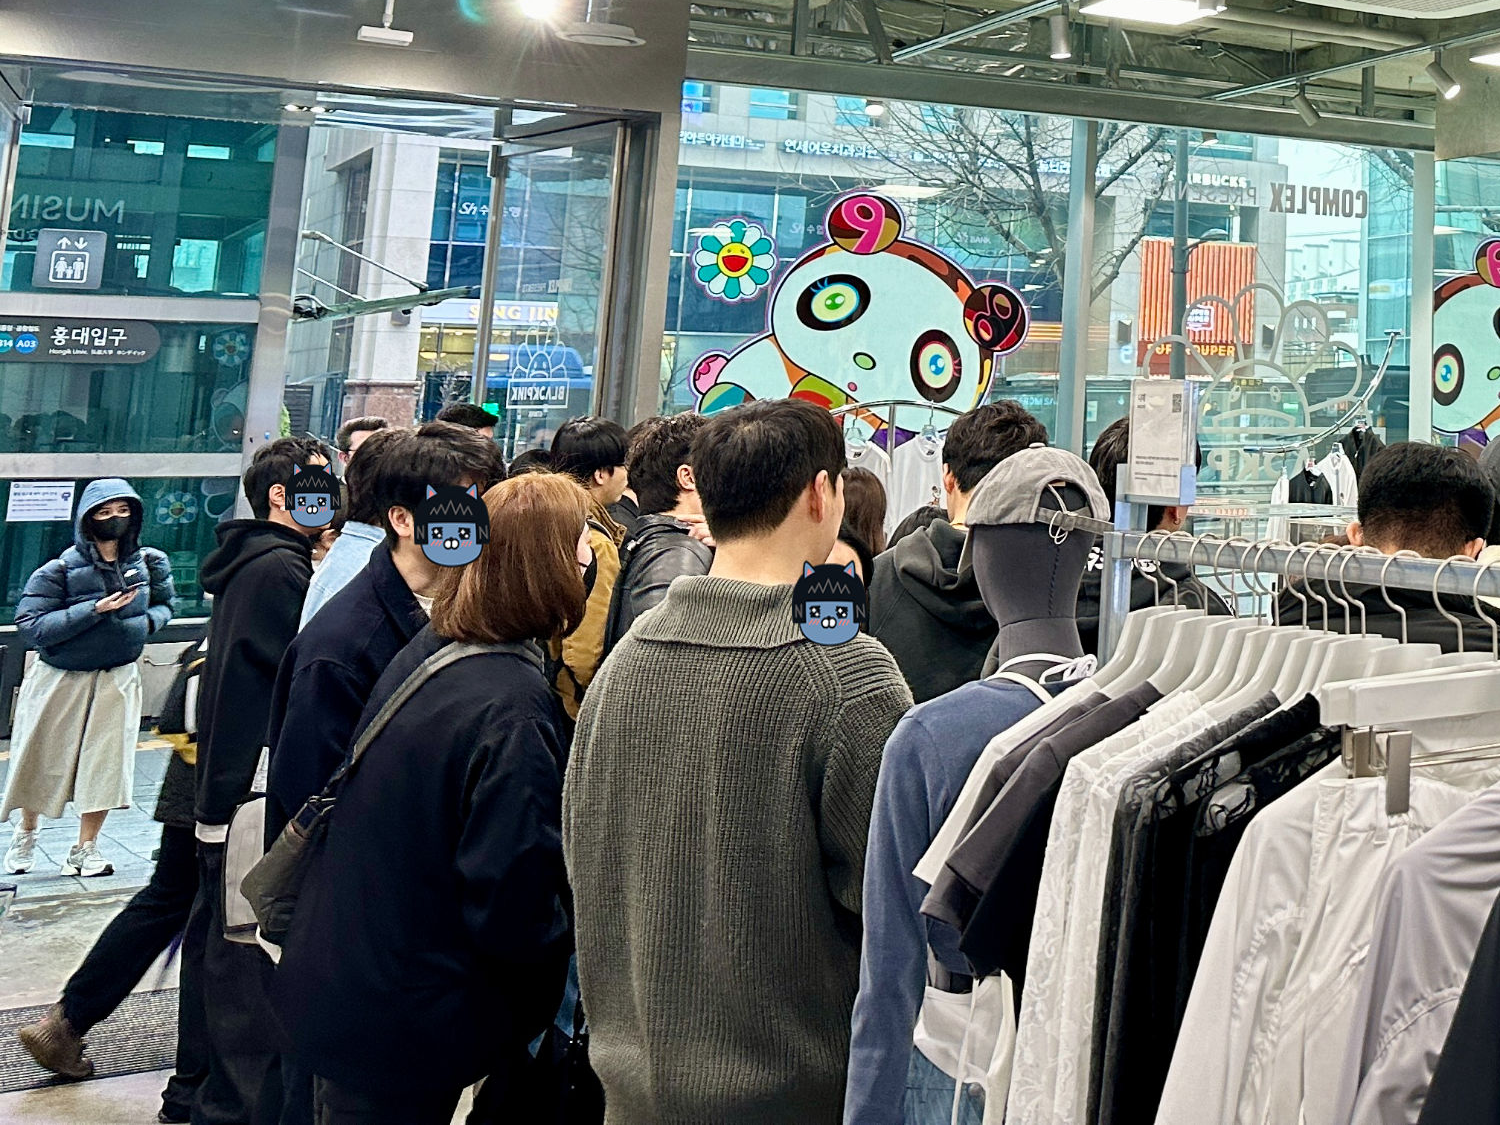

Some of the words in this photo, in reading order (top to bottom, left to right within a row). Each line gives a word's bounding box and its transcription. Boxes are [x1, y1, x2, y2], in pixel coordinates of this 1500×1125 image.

[1167, 171, 1247, 189] SRBUCKS
[458, 202, 477, 215] Sh
[469, 305, 521, 320] SNG
[528, 306, 559, 322] JIN
[16, 339, 36, 348] A03
[50, 325, 127, 346] 홍대입구
